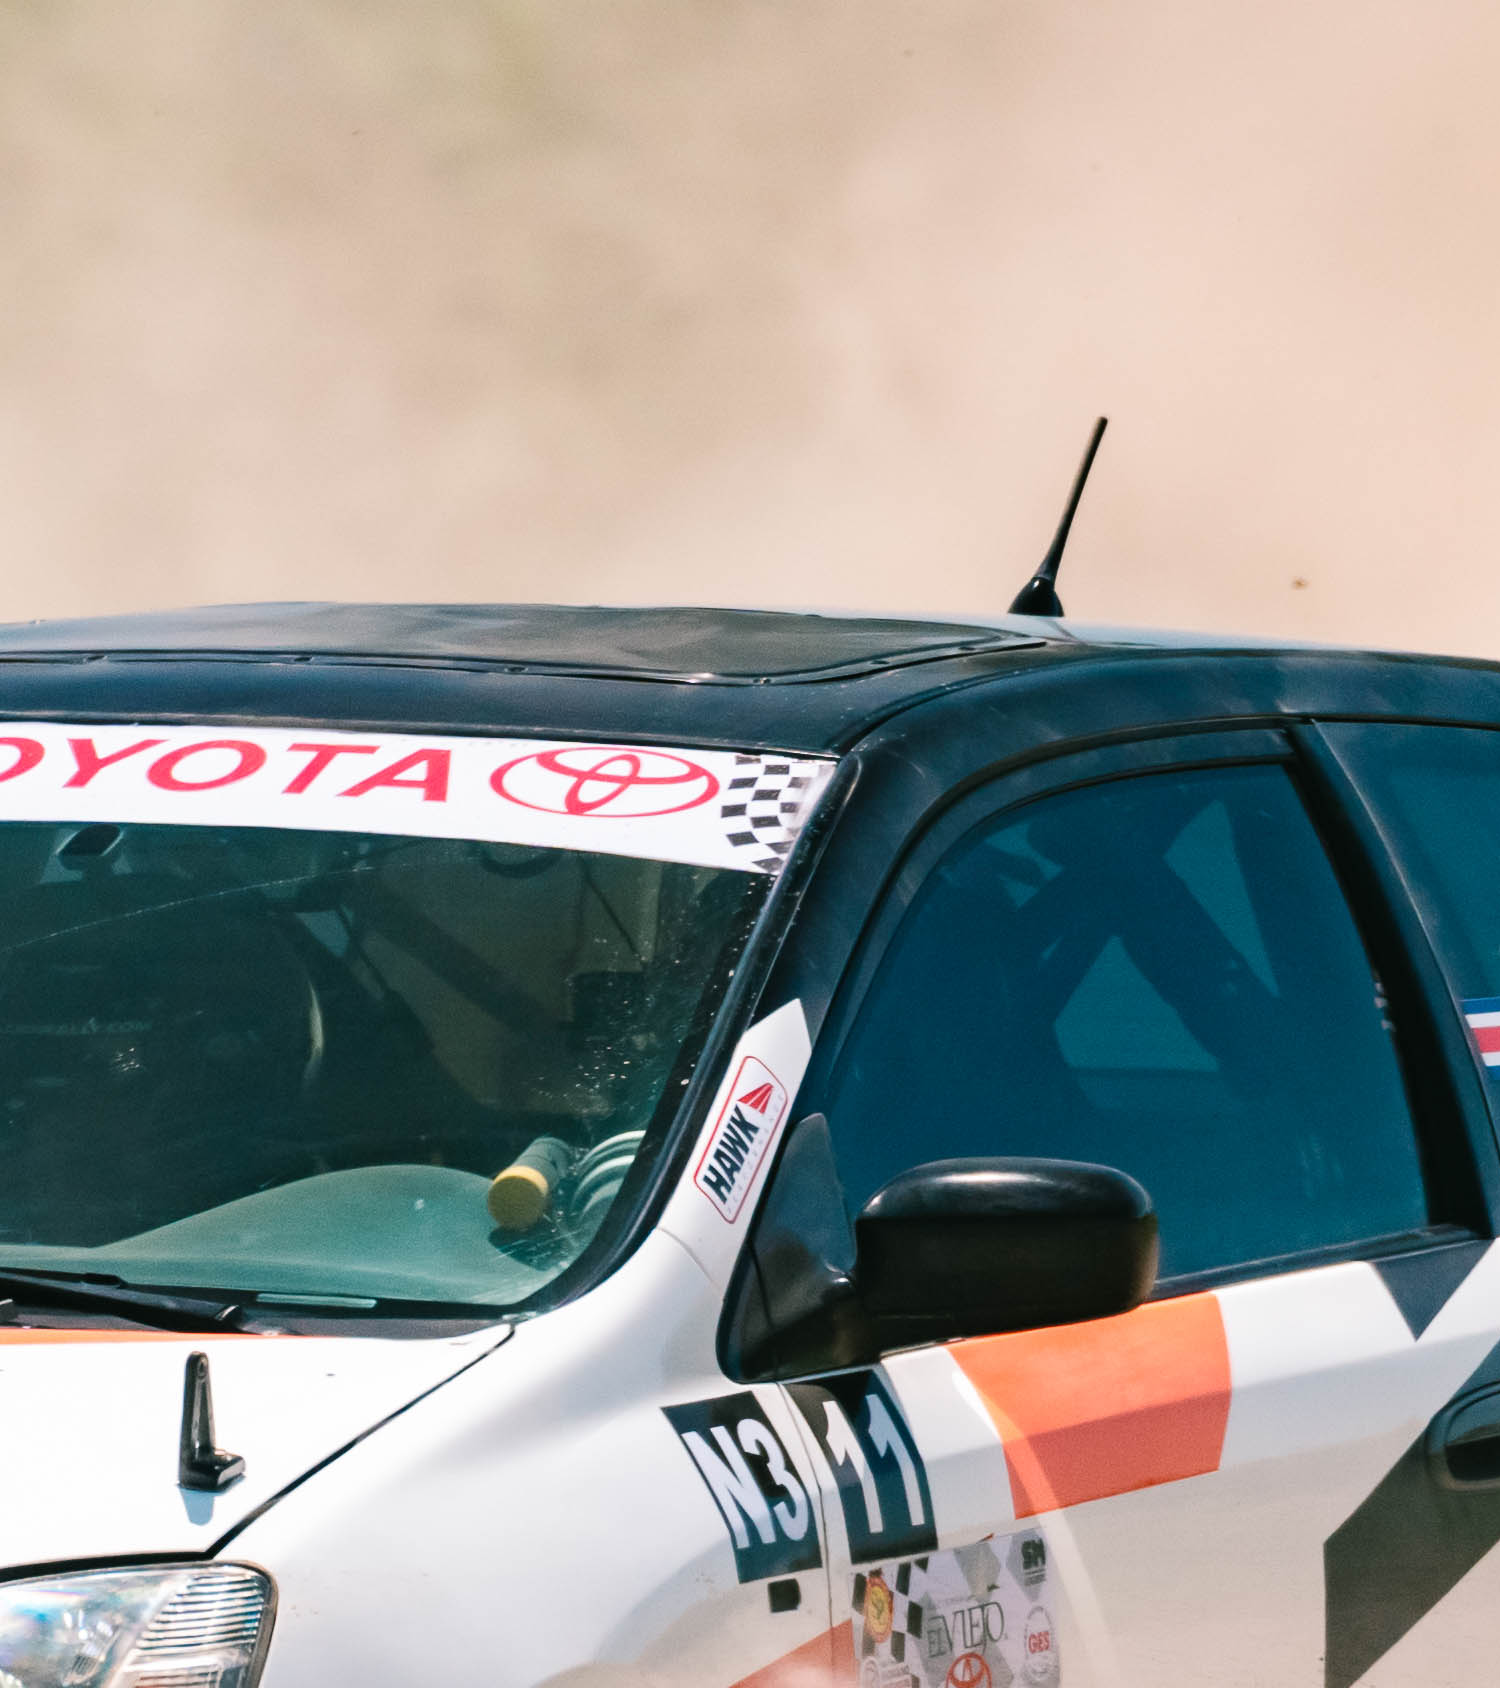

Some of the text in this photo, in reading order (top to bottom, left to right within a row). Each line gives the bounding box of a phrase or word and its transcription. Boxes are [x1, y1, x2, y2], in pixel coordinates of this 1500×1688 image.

[702, 1103, 760, 1205] HAWK
[681, 1418, 810, 1550] N3
[822, 1393, 926, 1535] 11
